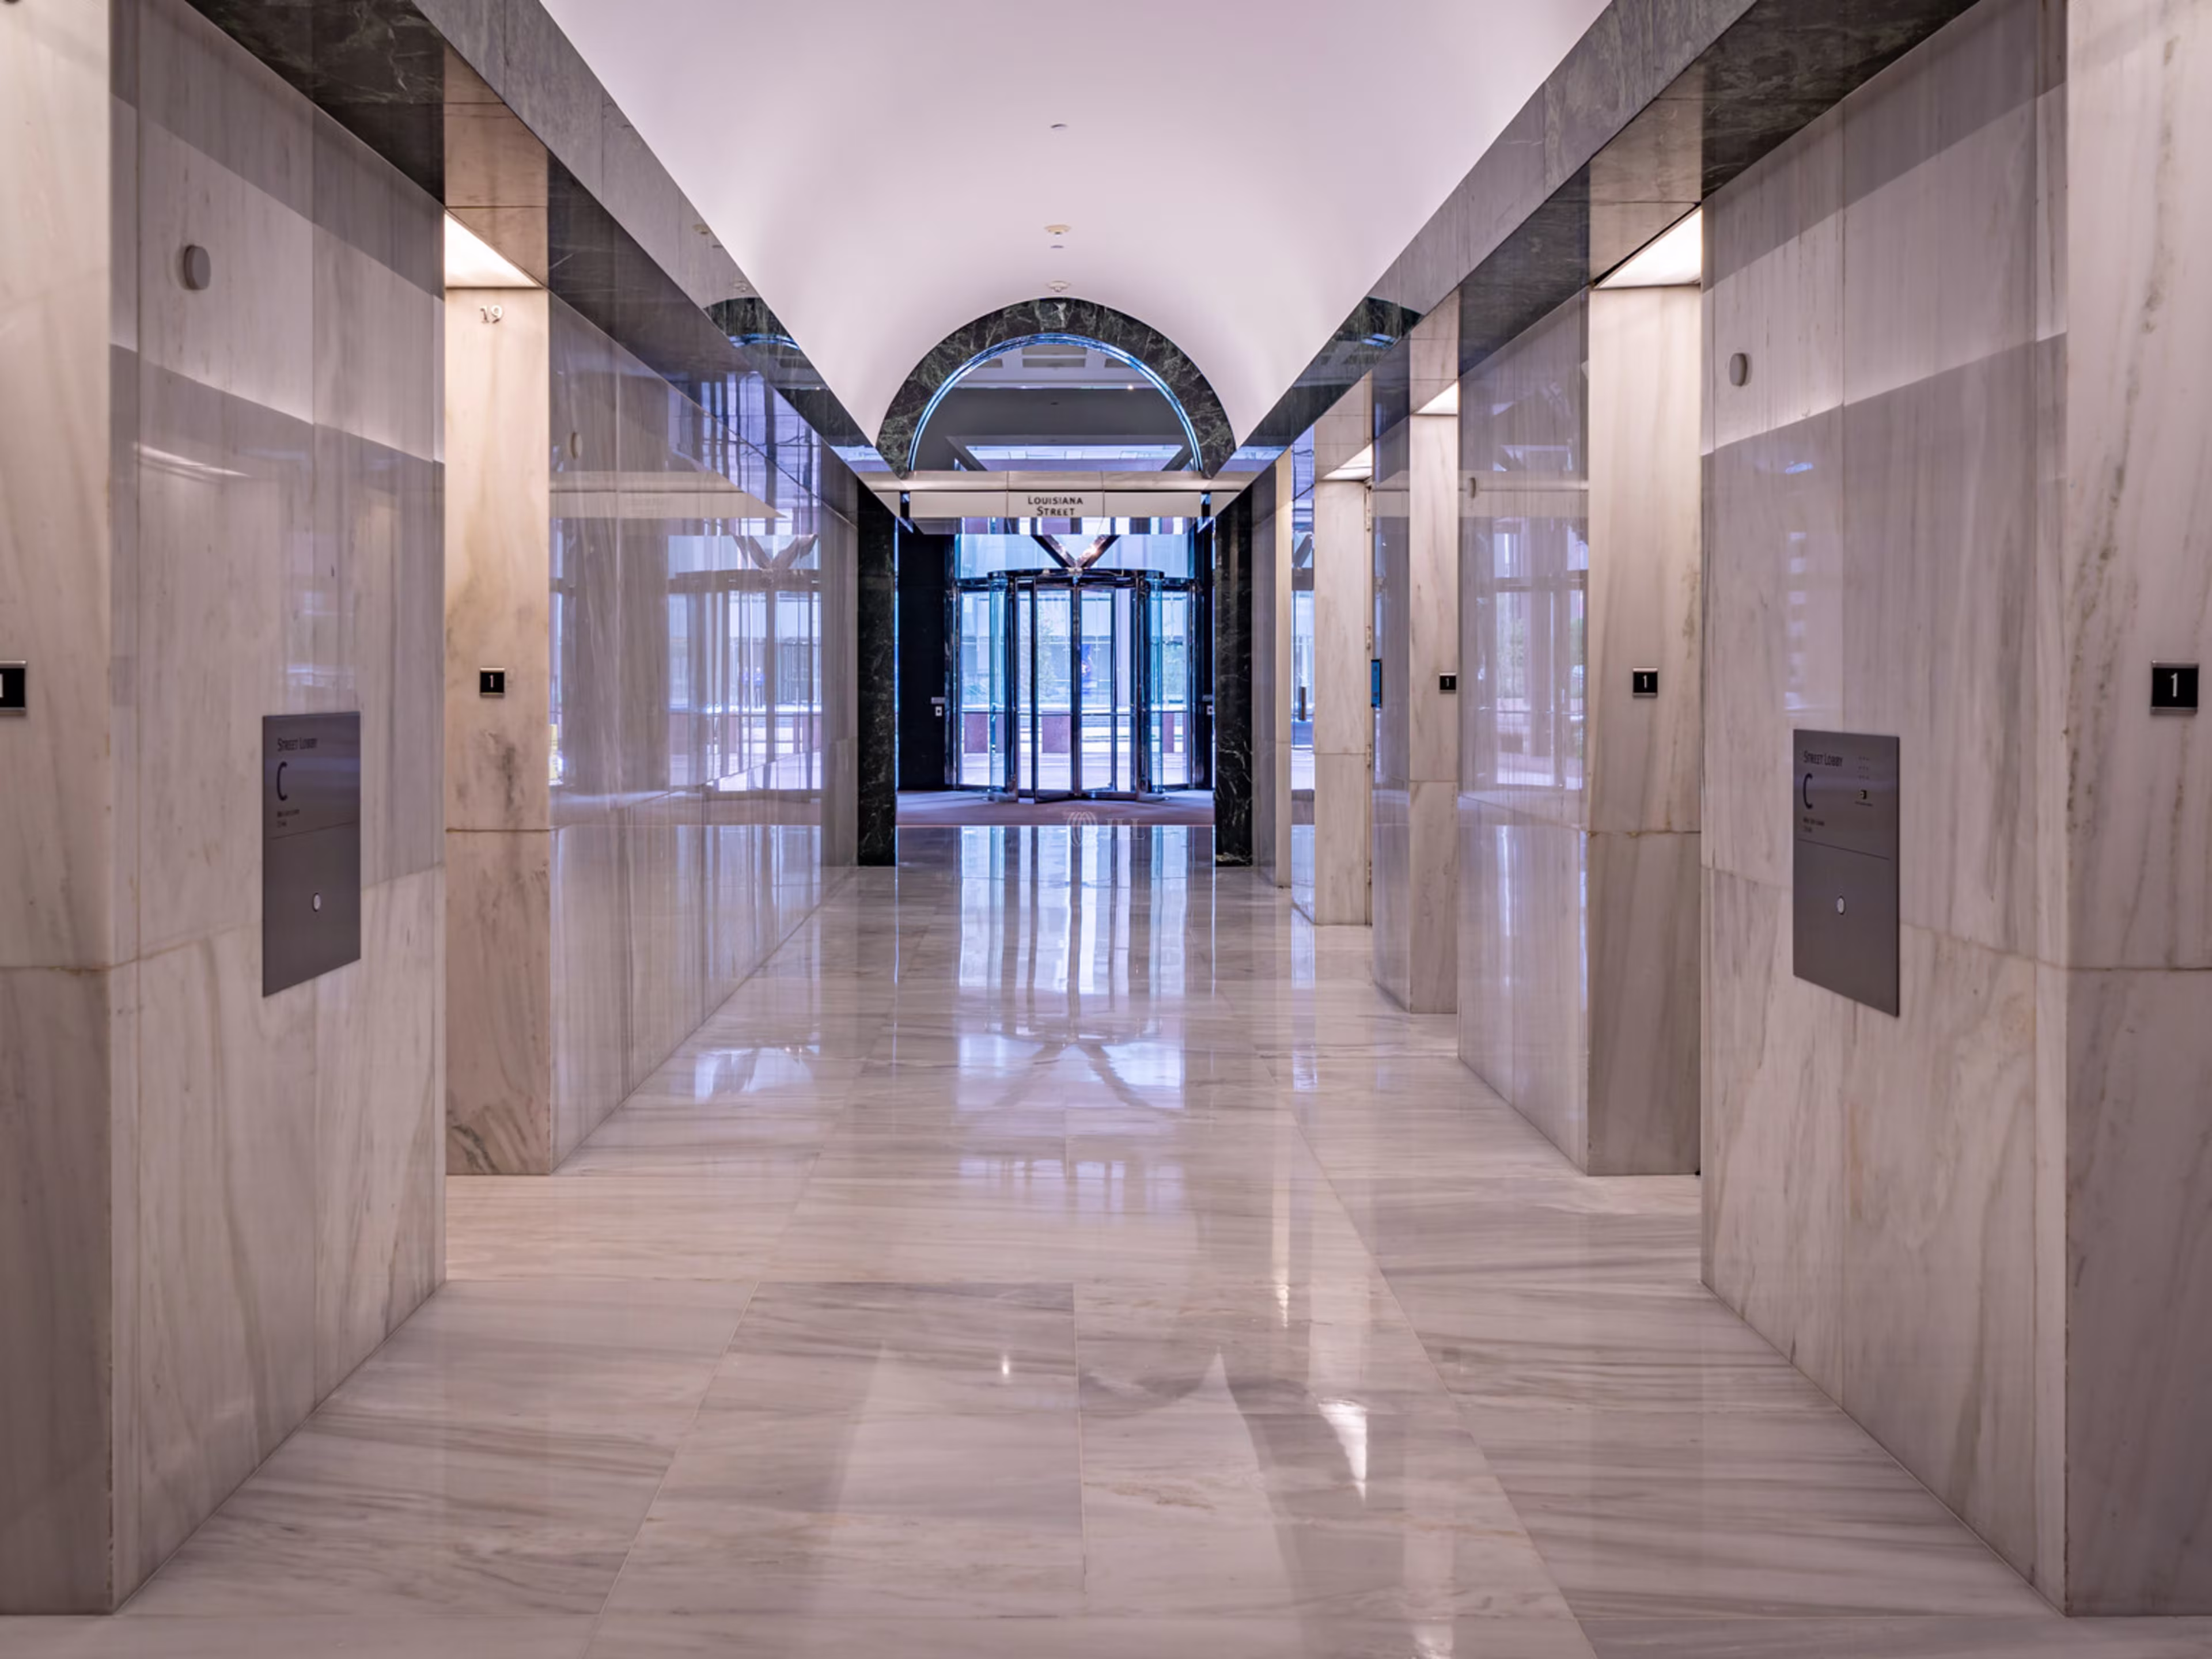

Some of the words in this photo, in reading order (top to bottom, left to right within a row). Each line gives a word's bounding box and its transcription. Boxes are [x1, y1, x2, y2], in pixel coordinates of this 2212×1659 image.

[479, 304, 503, 324] 19
[1028, 495, 1083, 505] LOUISIANA
[1037, 506, 1075, 516] STREET
[489, 675, 494, 688] 1
[1642, 675, 1647, 689] 1
[2171, 672, 2177, 698] 1
